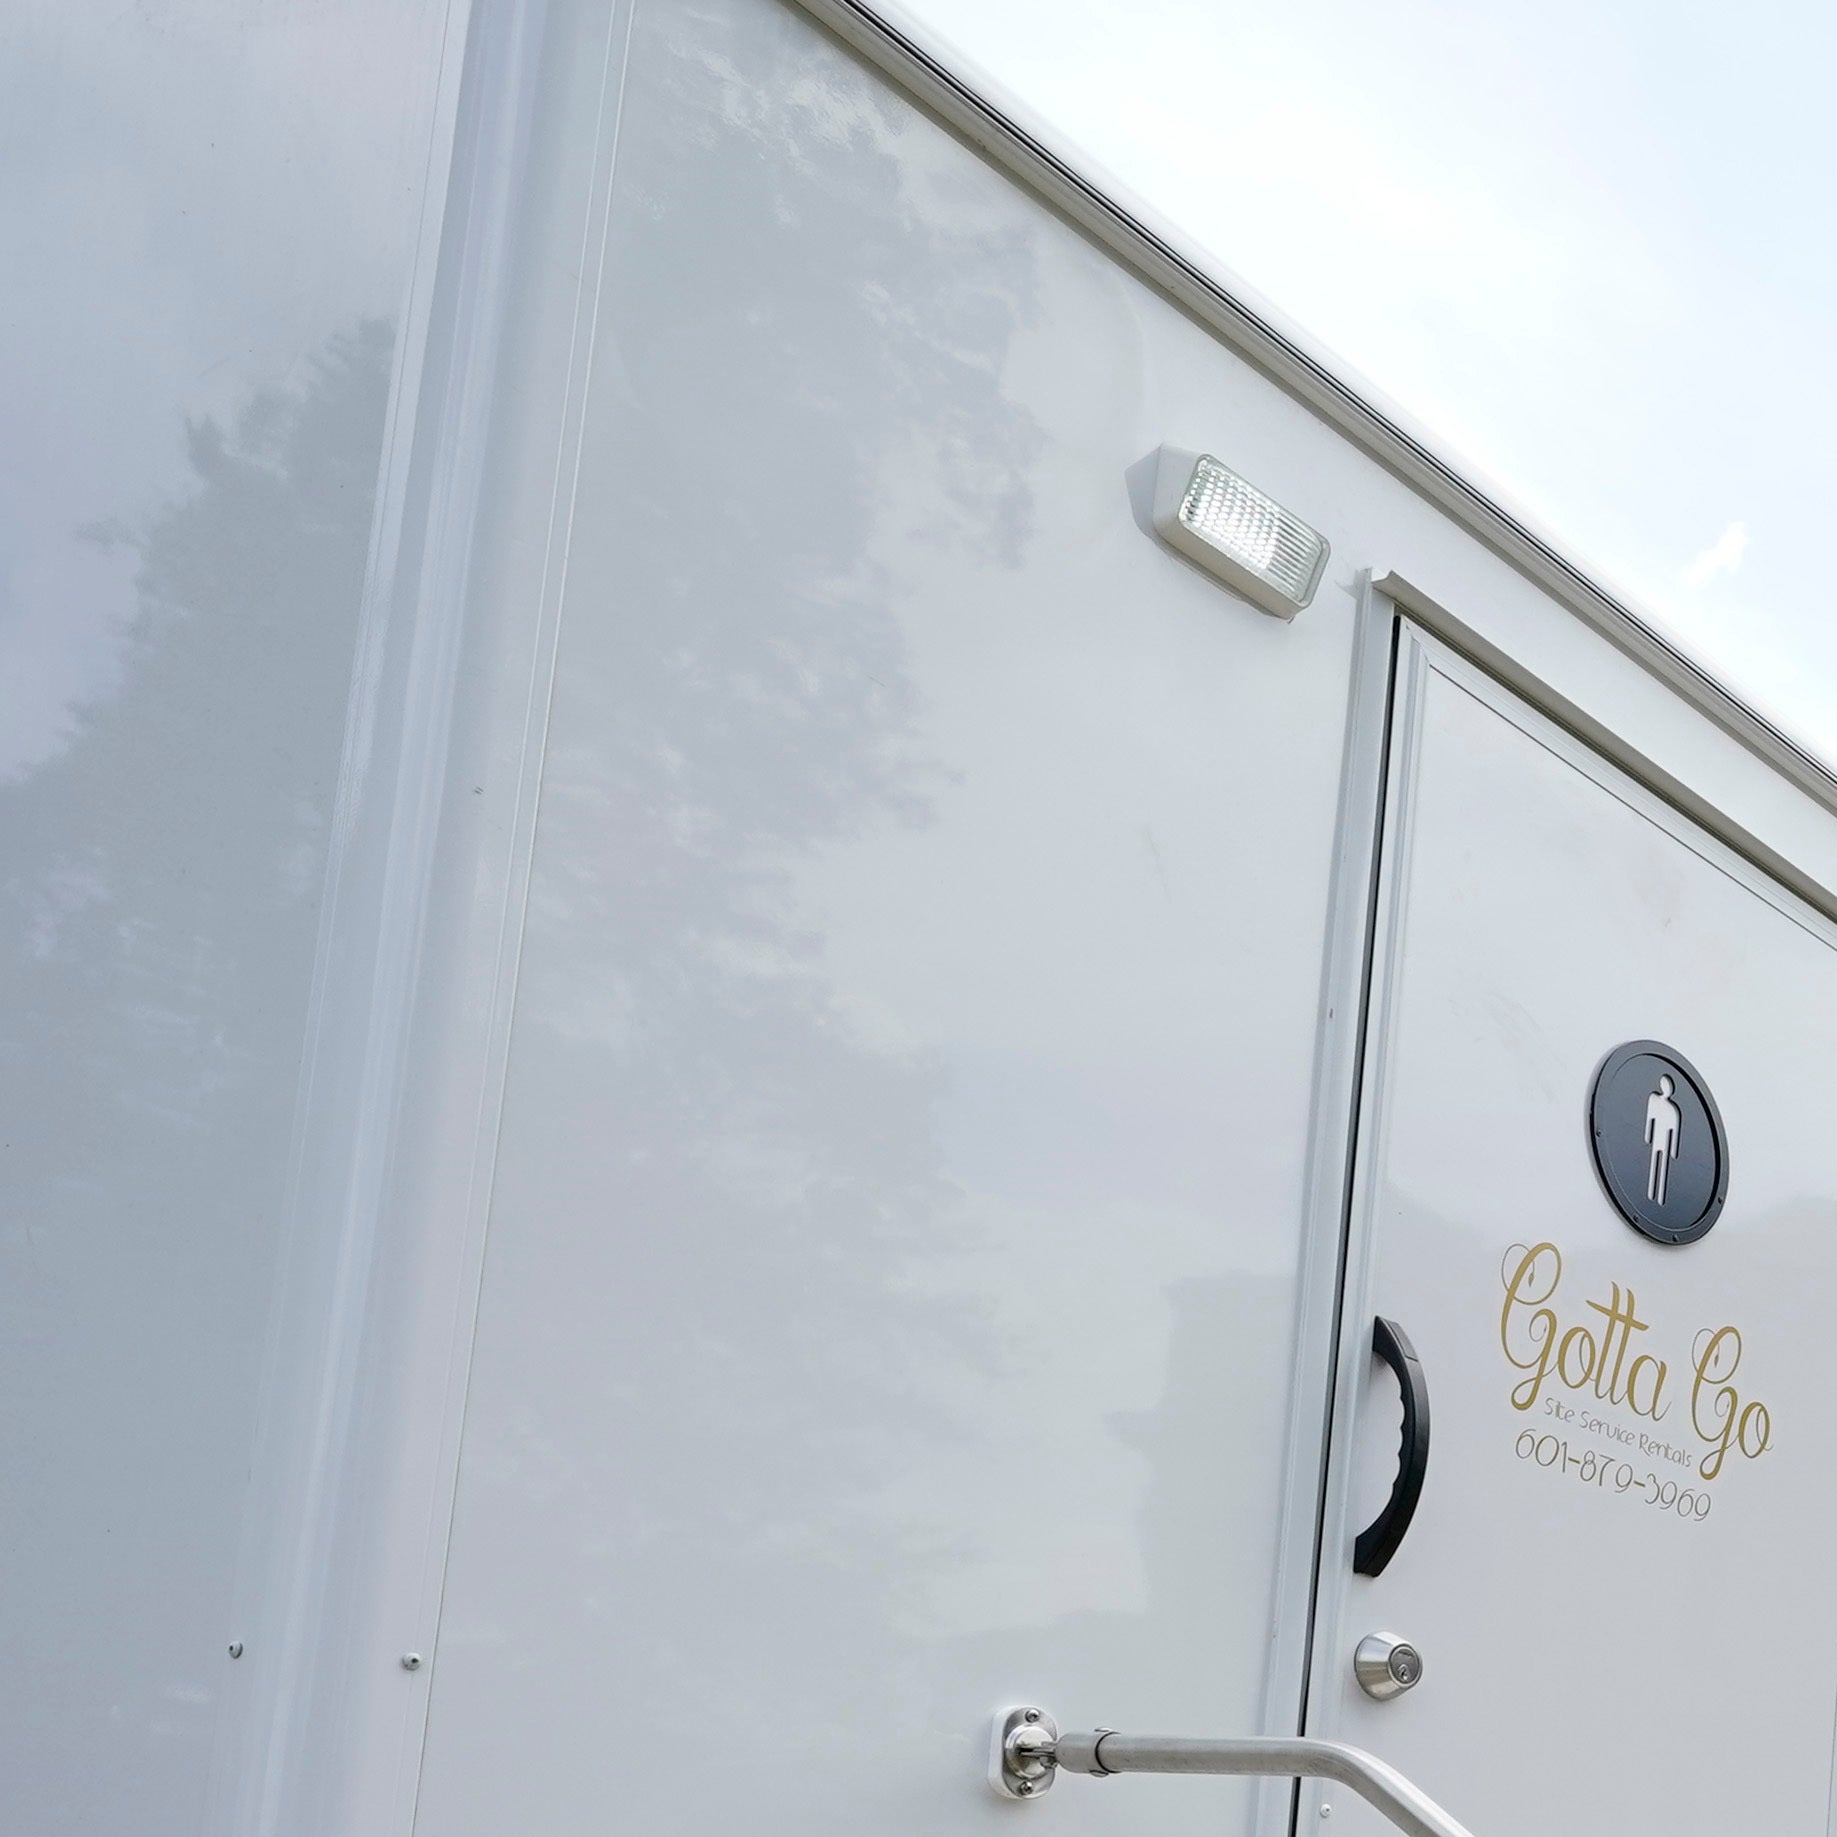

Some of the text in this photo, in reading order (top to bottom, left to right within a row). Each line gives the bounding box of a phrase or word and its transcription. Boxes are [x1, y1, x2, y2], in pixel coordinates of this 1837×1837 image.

[1500, 1241, 1774, 1481] Gotta Go
[1514, 1428, 1712, 1521] 601-879-3969
[1543, 1397, 1693, 1468] Site Service Rentals
